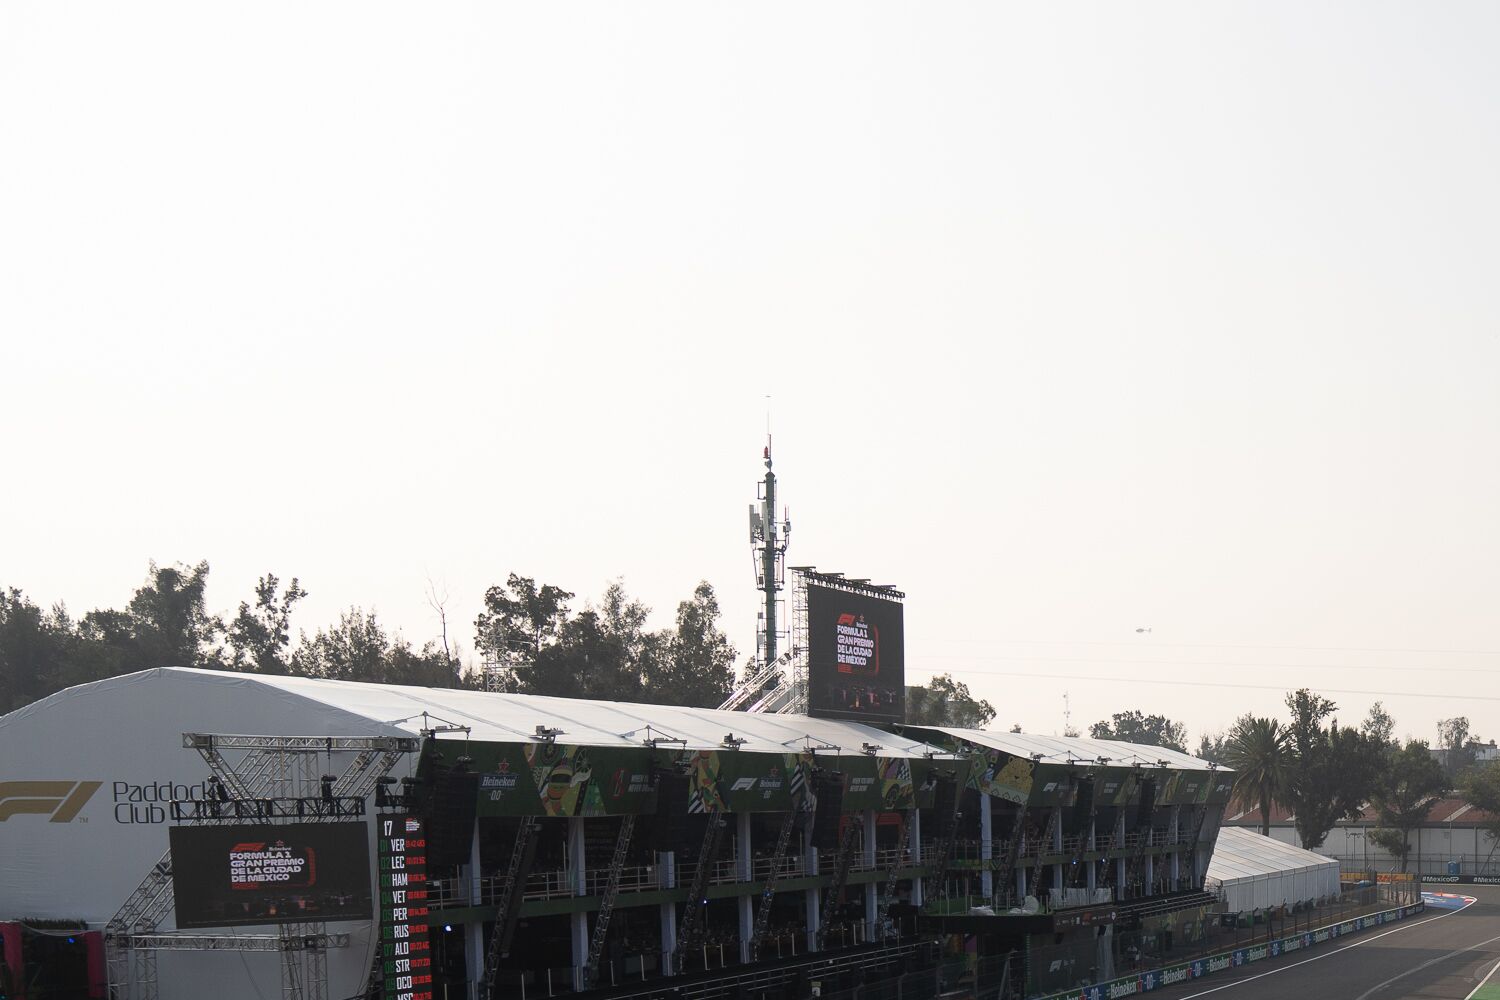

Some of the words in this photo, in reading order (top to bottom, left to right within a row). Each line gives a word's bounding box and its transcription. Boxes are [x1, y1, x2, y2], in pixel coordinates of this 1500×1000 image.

[837, 625, 863, 637] FORMULA
[838, 635, 853, 645] GRAN
[854, 638, 874, 648] PREMIO
[838, 644, 845, 653] DE
[846, 646, 853, 654] LA
[853, 647, 872, 657] CIUDAD
[838, 654, 845, 663] DE
[482, 776, 516, 787] Heineken
[113, 781, 213, 802] Paddock
[115, 803, 166, 824] Club
[384, 820, 392, 836] 17
[391, 839, 405, 852] VER
[230, 852, 284, 860] FORMULA
[264, 858, 304, 866] PREMIO
[392, 856, 404, 869] LEC
[392, 873, 408, 886] HAM
[393, 890, 406, 903] VET
[394, 908, 407, 920] PER
[394, 925, 409, 938] RUS
[395, 942, 409, 955] ALO
[396, 959, 410, 972] STR
[396, 976, 412, 989] OCO
[1164, 968, 1186, 984] Heineken
[1110, 980, 1136, 999] Heineken
